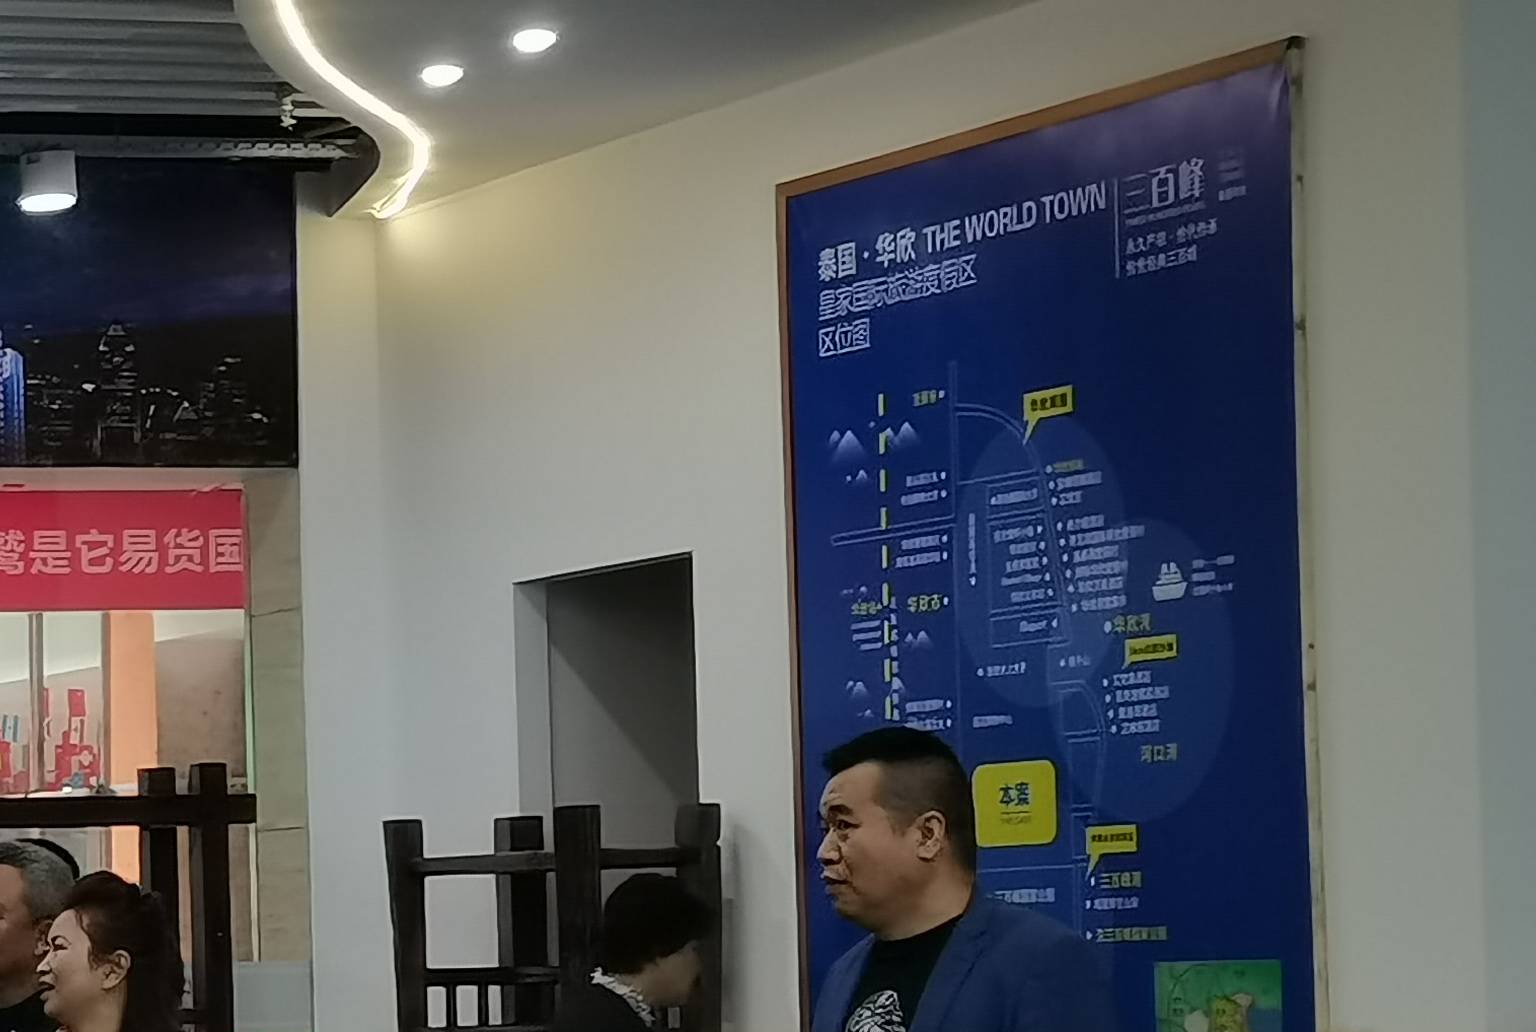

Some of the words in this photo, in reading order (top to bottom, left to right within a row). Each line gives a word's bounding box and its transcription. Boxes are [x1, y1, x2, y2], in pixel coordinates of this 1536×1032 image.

[922, 219, 961, 253] THE
[964, 200, 1037, 244] WORLD
[1040, 180, 1106, 224] TOWN
[818, 318, 871, 357] 区位图
[998, 781, 1030, 806] 本案
